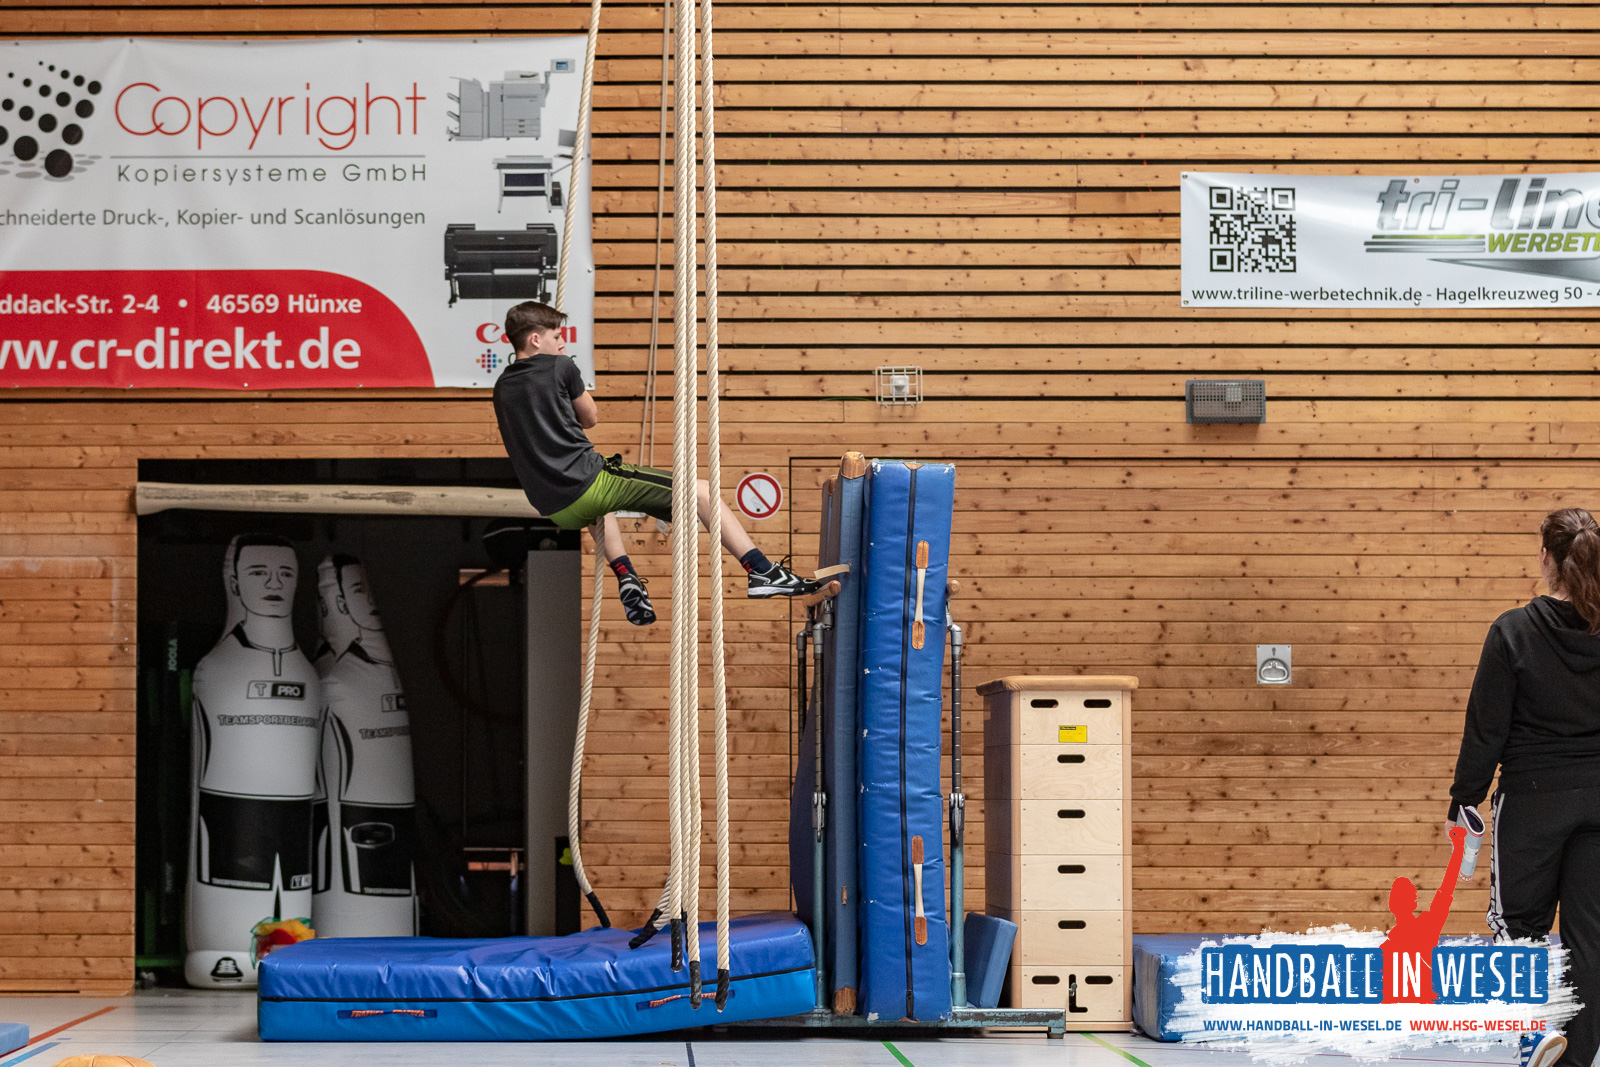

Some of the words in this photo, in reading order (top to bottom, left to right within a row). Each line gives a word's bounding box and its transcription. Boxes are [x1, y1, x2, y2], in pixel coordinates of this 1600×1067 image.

[114, 82, 426, 151] Copyright
[117, 164, 327, 186] Kopiersysteme
[342, 163, 426, 182] GmbH
[102, 208, 169, 228] Druck-,
[177, 208, 243, 230] Kopier-
[250, 207, 287, 225] und
[294, 207, 426, 229] Scanlösungen
[122, 294, 160, 314] 2-4
[206, 293, 280, 314] 46569
[288, 294, 362, 314] Hünxe
[1191, 286, 1423, 301] www.triline-werbetechnik.de
[1436, 286, 1559, 305] Hagelkreuzweg
[1563, 286, 1583, 301] 50
[277, 685, 301, 697] PRO
